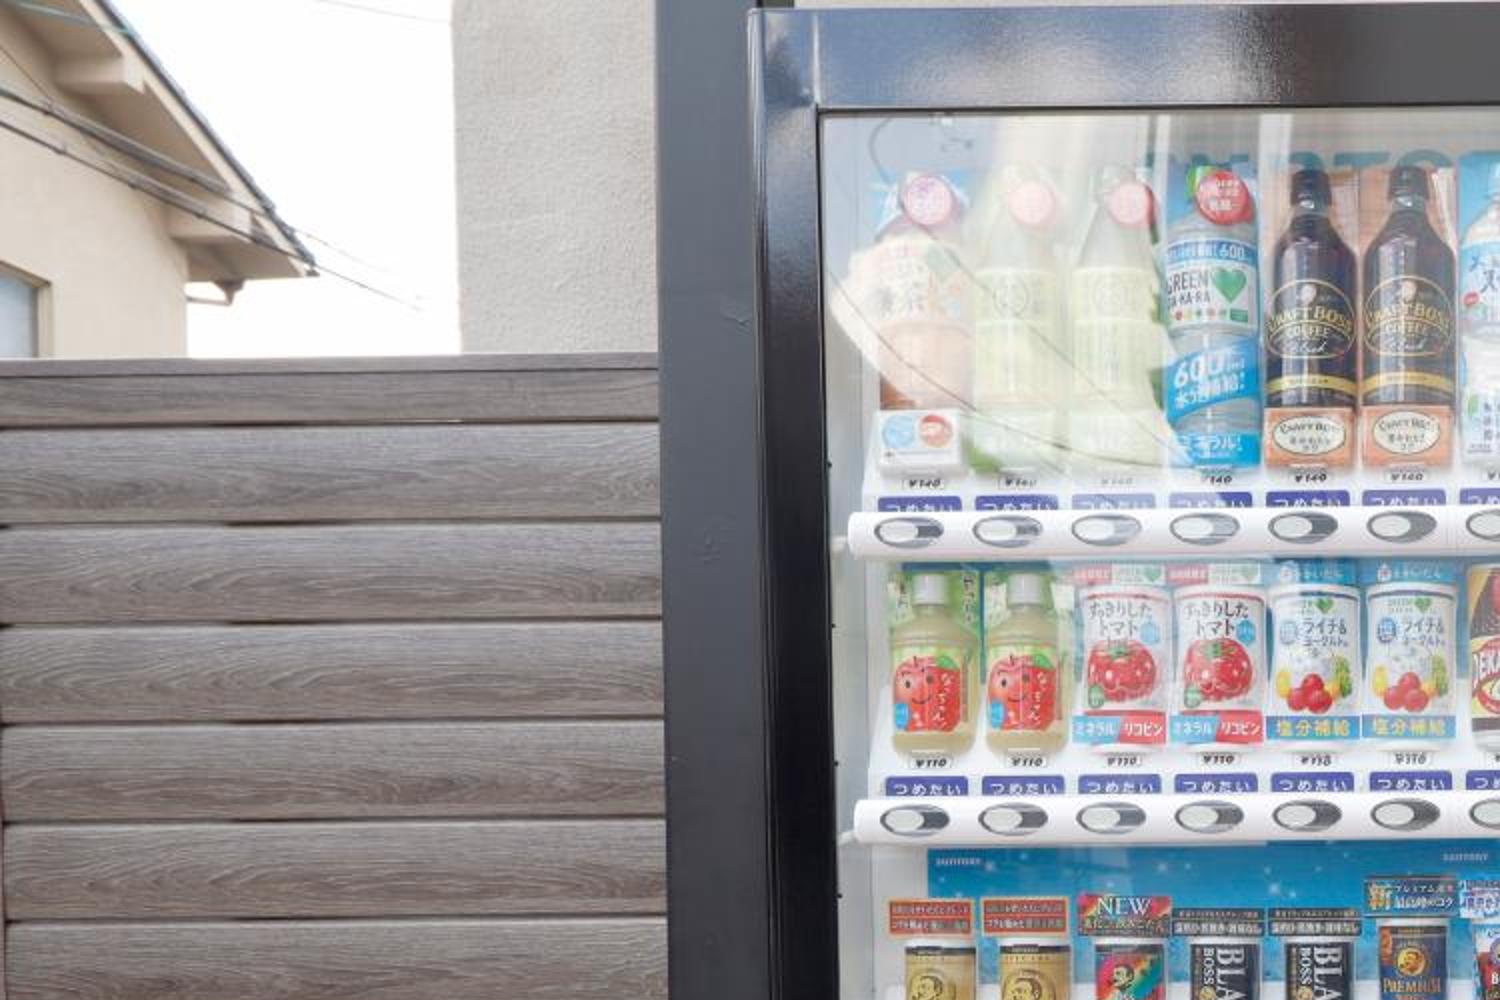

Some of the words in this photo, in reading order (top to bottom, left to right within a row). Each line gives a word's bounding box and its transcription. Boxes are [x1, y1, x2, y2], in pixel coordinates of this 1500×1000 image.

[1088, 602, 1153, 619] すっきりした
[1184, 601, 1249, 618] すっきりした
[1100, 619, 1139, 636] トマト
[1197, 619, 1236, 636] トマト
[1124, 722, 1163, 736] リコピン
[1221, 721, 1261, 736] リコピン
[893, 783, 961, 796] つめたい
[990, 782, 1057, 795] つめたい
[1085, 781, 1153, 794] つめたい
[1184, 780, 1250, 793] つめたい
[1279, 779, 1347, 792] つめたい
[1377, 778, 1445, 791] つめたい
[1095, 896, 1152, 916] NEW
[1203, 947, 1214, 985] BOSS
[1300, 946, 1312, 985] BOSS
